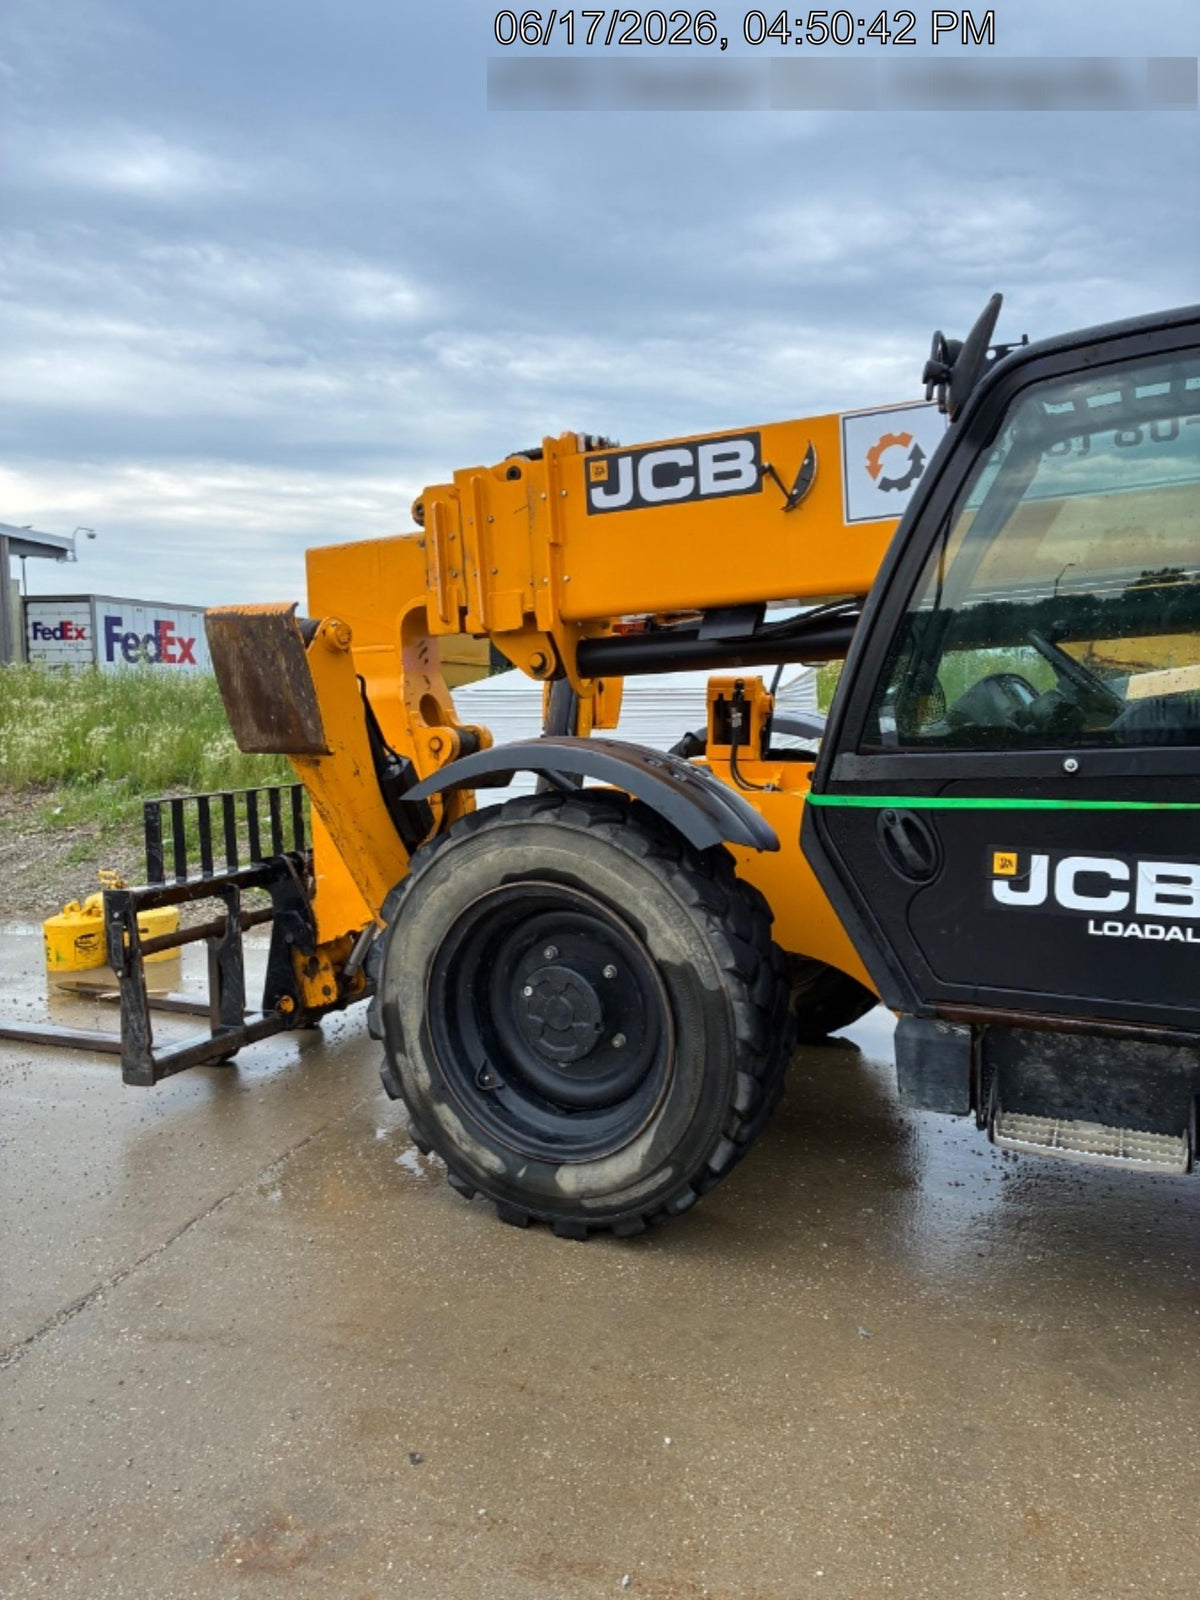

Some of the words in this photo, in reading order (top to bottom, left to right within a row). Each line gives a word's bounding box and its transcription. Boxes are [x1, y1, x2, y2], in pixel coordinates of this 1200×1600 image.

[590, 439, 758, 509] JCB
[32, 620, 86, 641] FedEx
[104, 615, 197, 666] FedEx
[992, 854, 1200, 918] JCB
